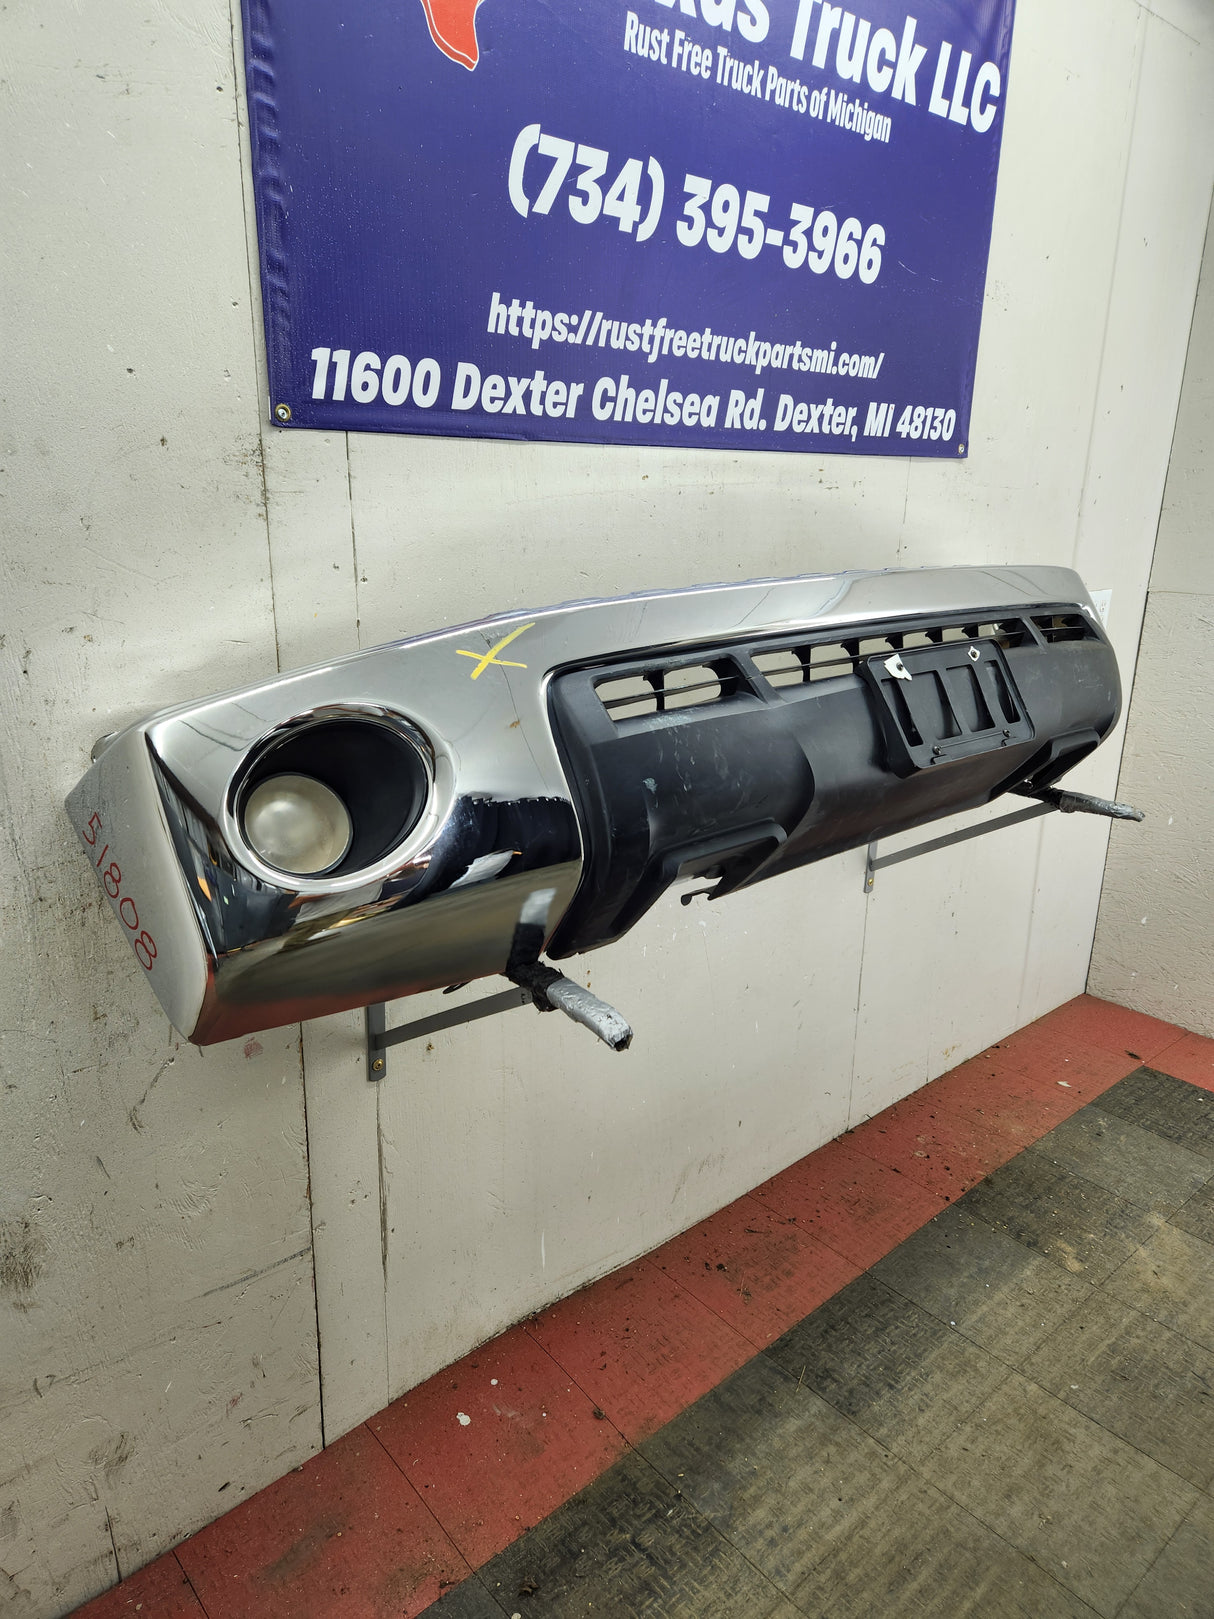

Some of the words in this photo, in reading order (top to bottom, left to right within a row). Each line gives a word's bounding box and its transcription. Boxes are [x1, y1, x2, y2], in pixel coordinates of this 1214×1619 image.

[623, 10, 671, 66] Rust
[671, 28, 713, 80] Free
[716, 44, 764, 99] Truck
[764, 64, 808, 115] Parts
[809, 86, 829, 120] of
[826, 88, 892, 144] Michigan
[789, 0, 929, 107] Truck
[927, 40, 1001, 133] LLC
[507, 123, 665, 243] (734)
[676, 173, 886, 285] 395-3966
[310, 346, 441, 408] 11600
[451, 361, 585, 419] Dexter
[591, 374, 720, 429] Chelsea
[723, 387, 767, 432] Rd.
[773, 393, 858, 443] Dexter,
[863, 401, 896, 438] MI
[895, 404, 957, 443] 48130
[486, 291, 886, 381] https://rustfreetruckpartsmi.com/
[82, 811, 158, 971] 51808
